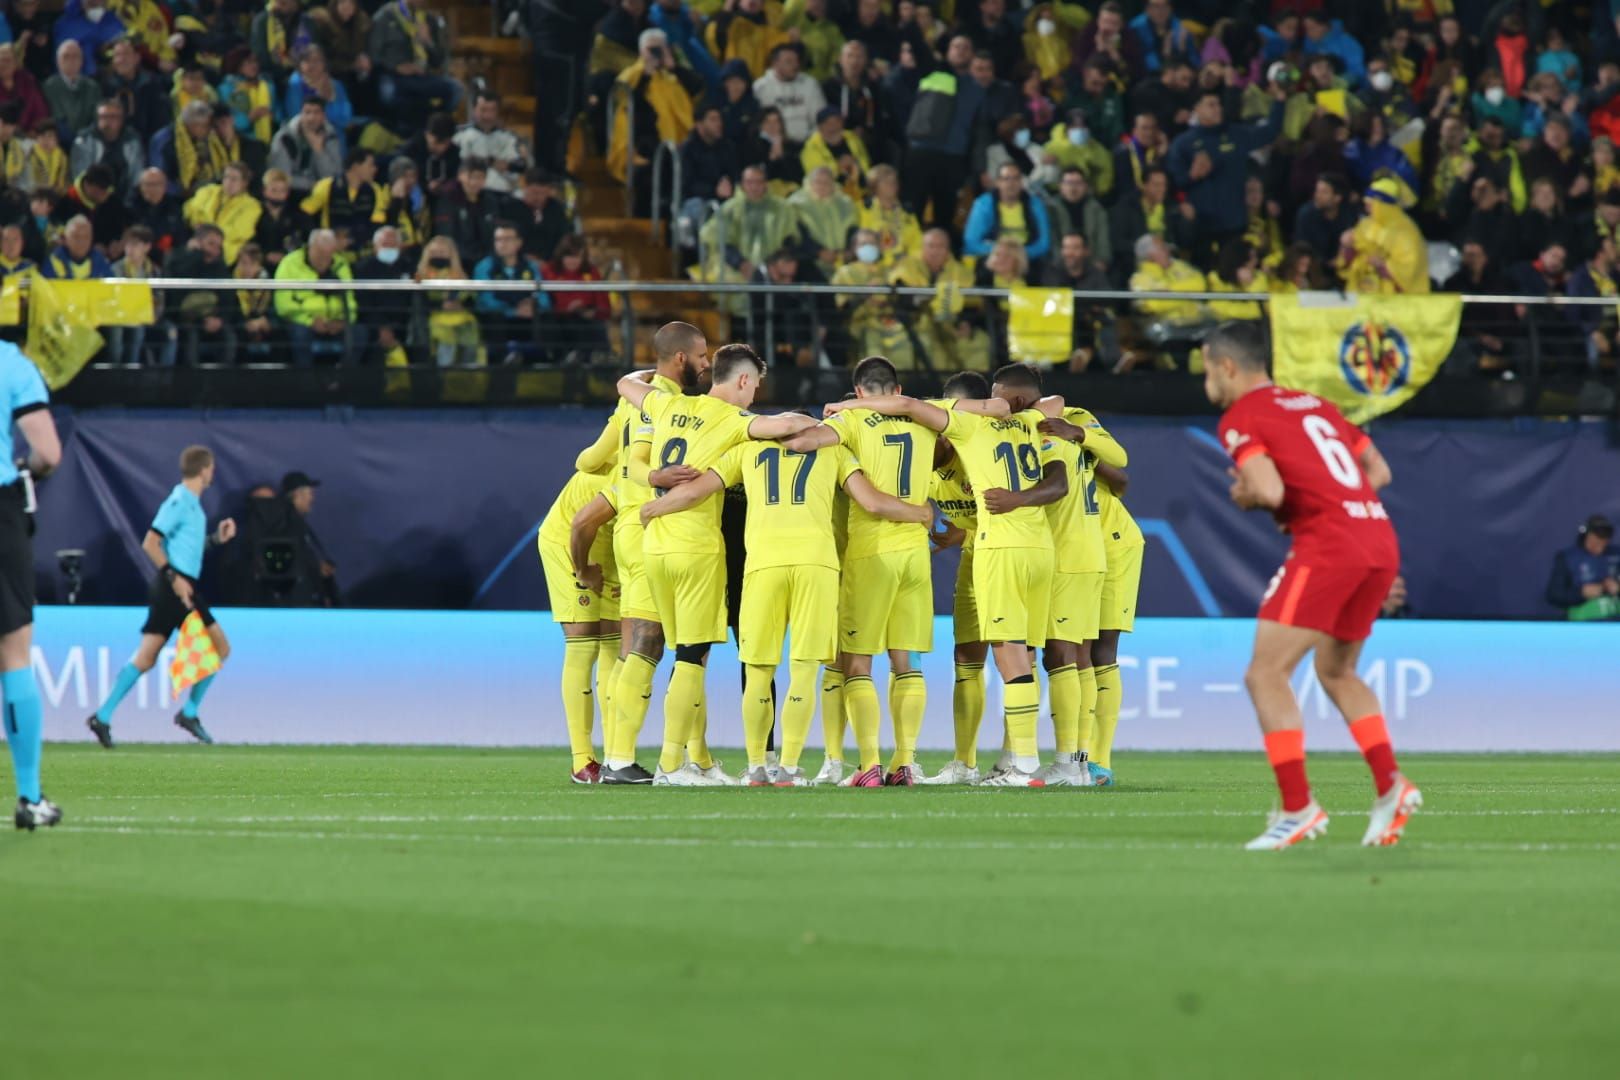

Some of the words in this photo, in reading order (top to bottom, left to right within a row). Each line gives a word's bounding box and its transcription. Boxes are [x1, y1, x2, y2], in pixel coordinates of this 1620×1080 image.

[755, 446, 817, 505] 17
[882, 431, 913, 498] 7
[1302, 414, 1362, 490] 6
